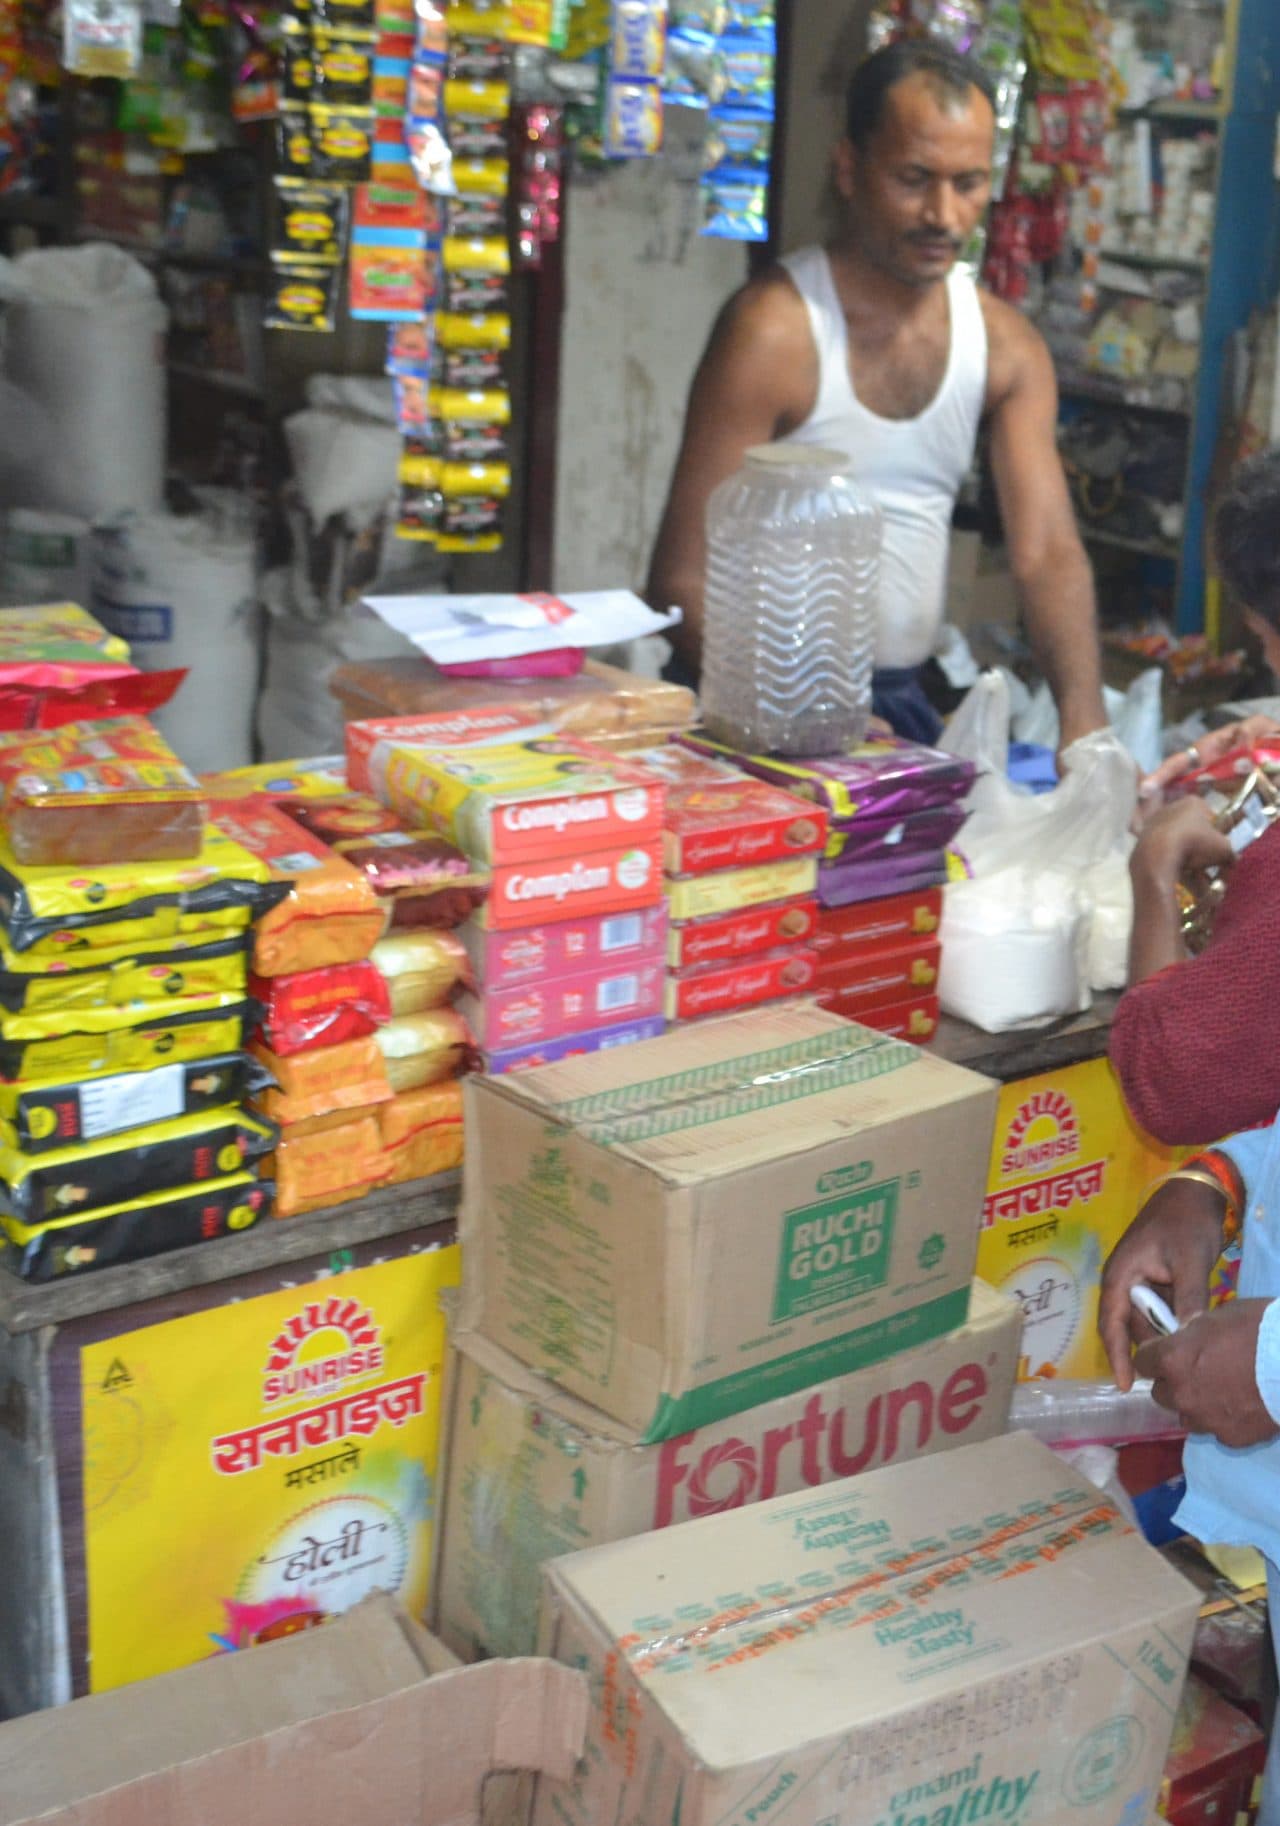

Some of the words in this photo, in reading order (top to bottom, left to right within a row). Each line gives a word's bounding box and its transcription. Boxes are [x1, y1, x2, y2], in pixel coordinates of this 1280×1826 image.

[372, 712, 518, 738] Complan
[503, 798, 609, 832] Complan
[505, 863, 611, 901] Complan
[1001, 1133, 1080, 1174] SUNRISE
[791, 1199, 887, 1253] RUCHI
[1008, 1213, 1060, 1248] मसाले
[789, 1229, 882, 1281] GOLD
[263, 1346, 383, 1402] SUNRISE
[212, 1371, 428, 1475] सनराइज़
[654, 1362, 988, 1530] Fortune
[285, 1442, 362, 1489] मसाले
[262, 1519, 386, 1582] होली
[874, 1608, 963, 1647] Healthy
